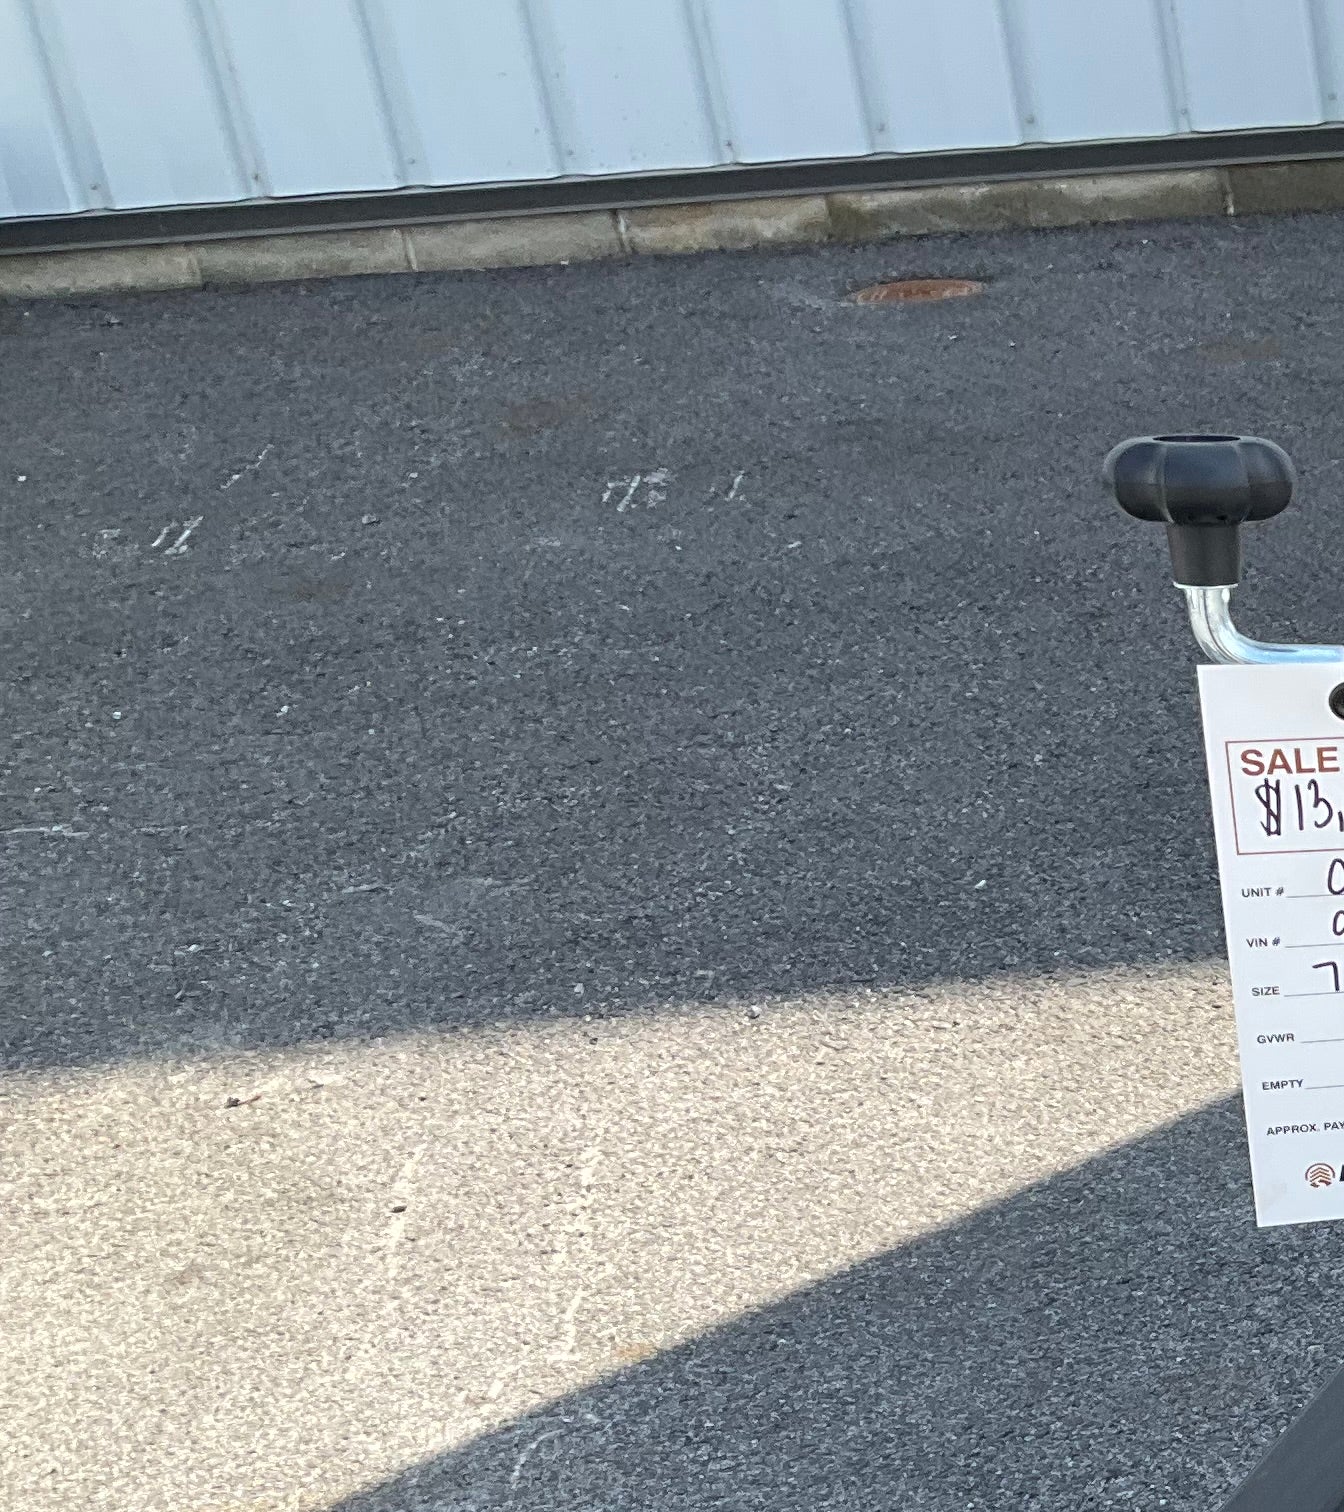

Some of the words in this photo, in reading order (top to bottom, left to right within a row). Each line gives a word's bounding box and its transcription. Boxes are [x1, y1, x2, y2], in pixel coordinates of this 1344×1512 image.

[1240, 746, 1341, 776] SALE
[1241, 887, 1271, 898] UNIT
[1275, 885, 1284, 897] #
[1246, 937, 1268, 948] VIN
[1272, 936, 1281, 947] #
[1251, 986, 1280, 997] SIZE
[1257, 1032, 1295, 1044] GVWR
[1262, 1079, 1304, 1091] EMPTY
[1266, 1122, 1320, 1136] APPROX.
